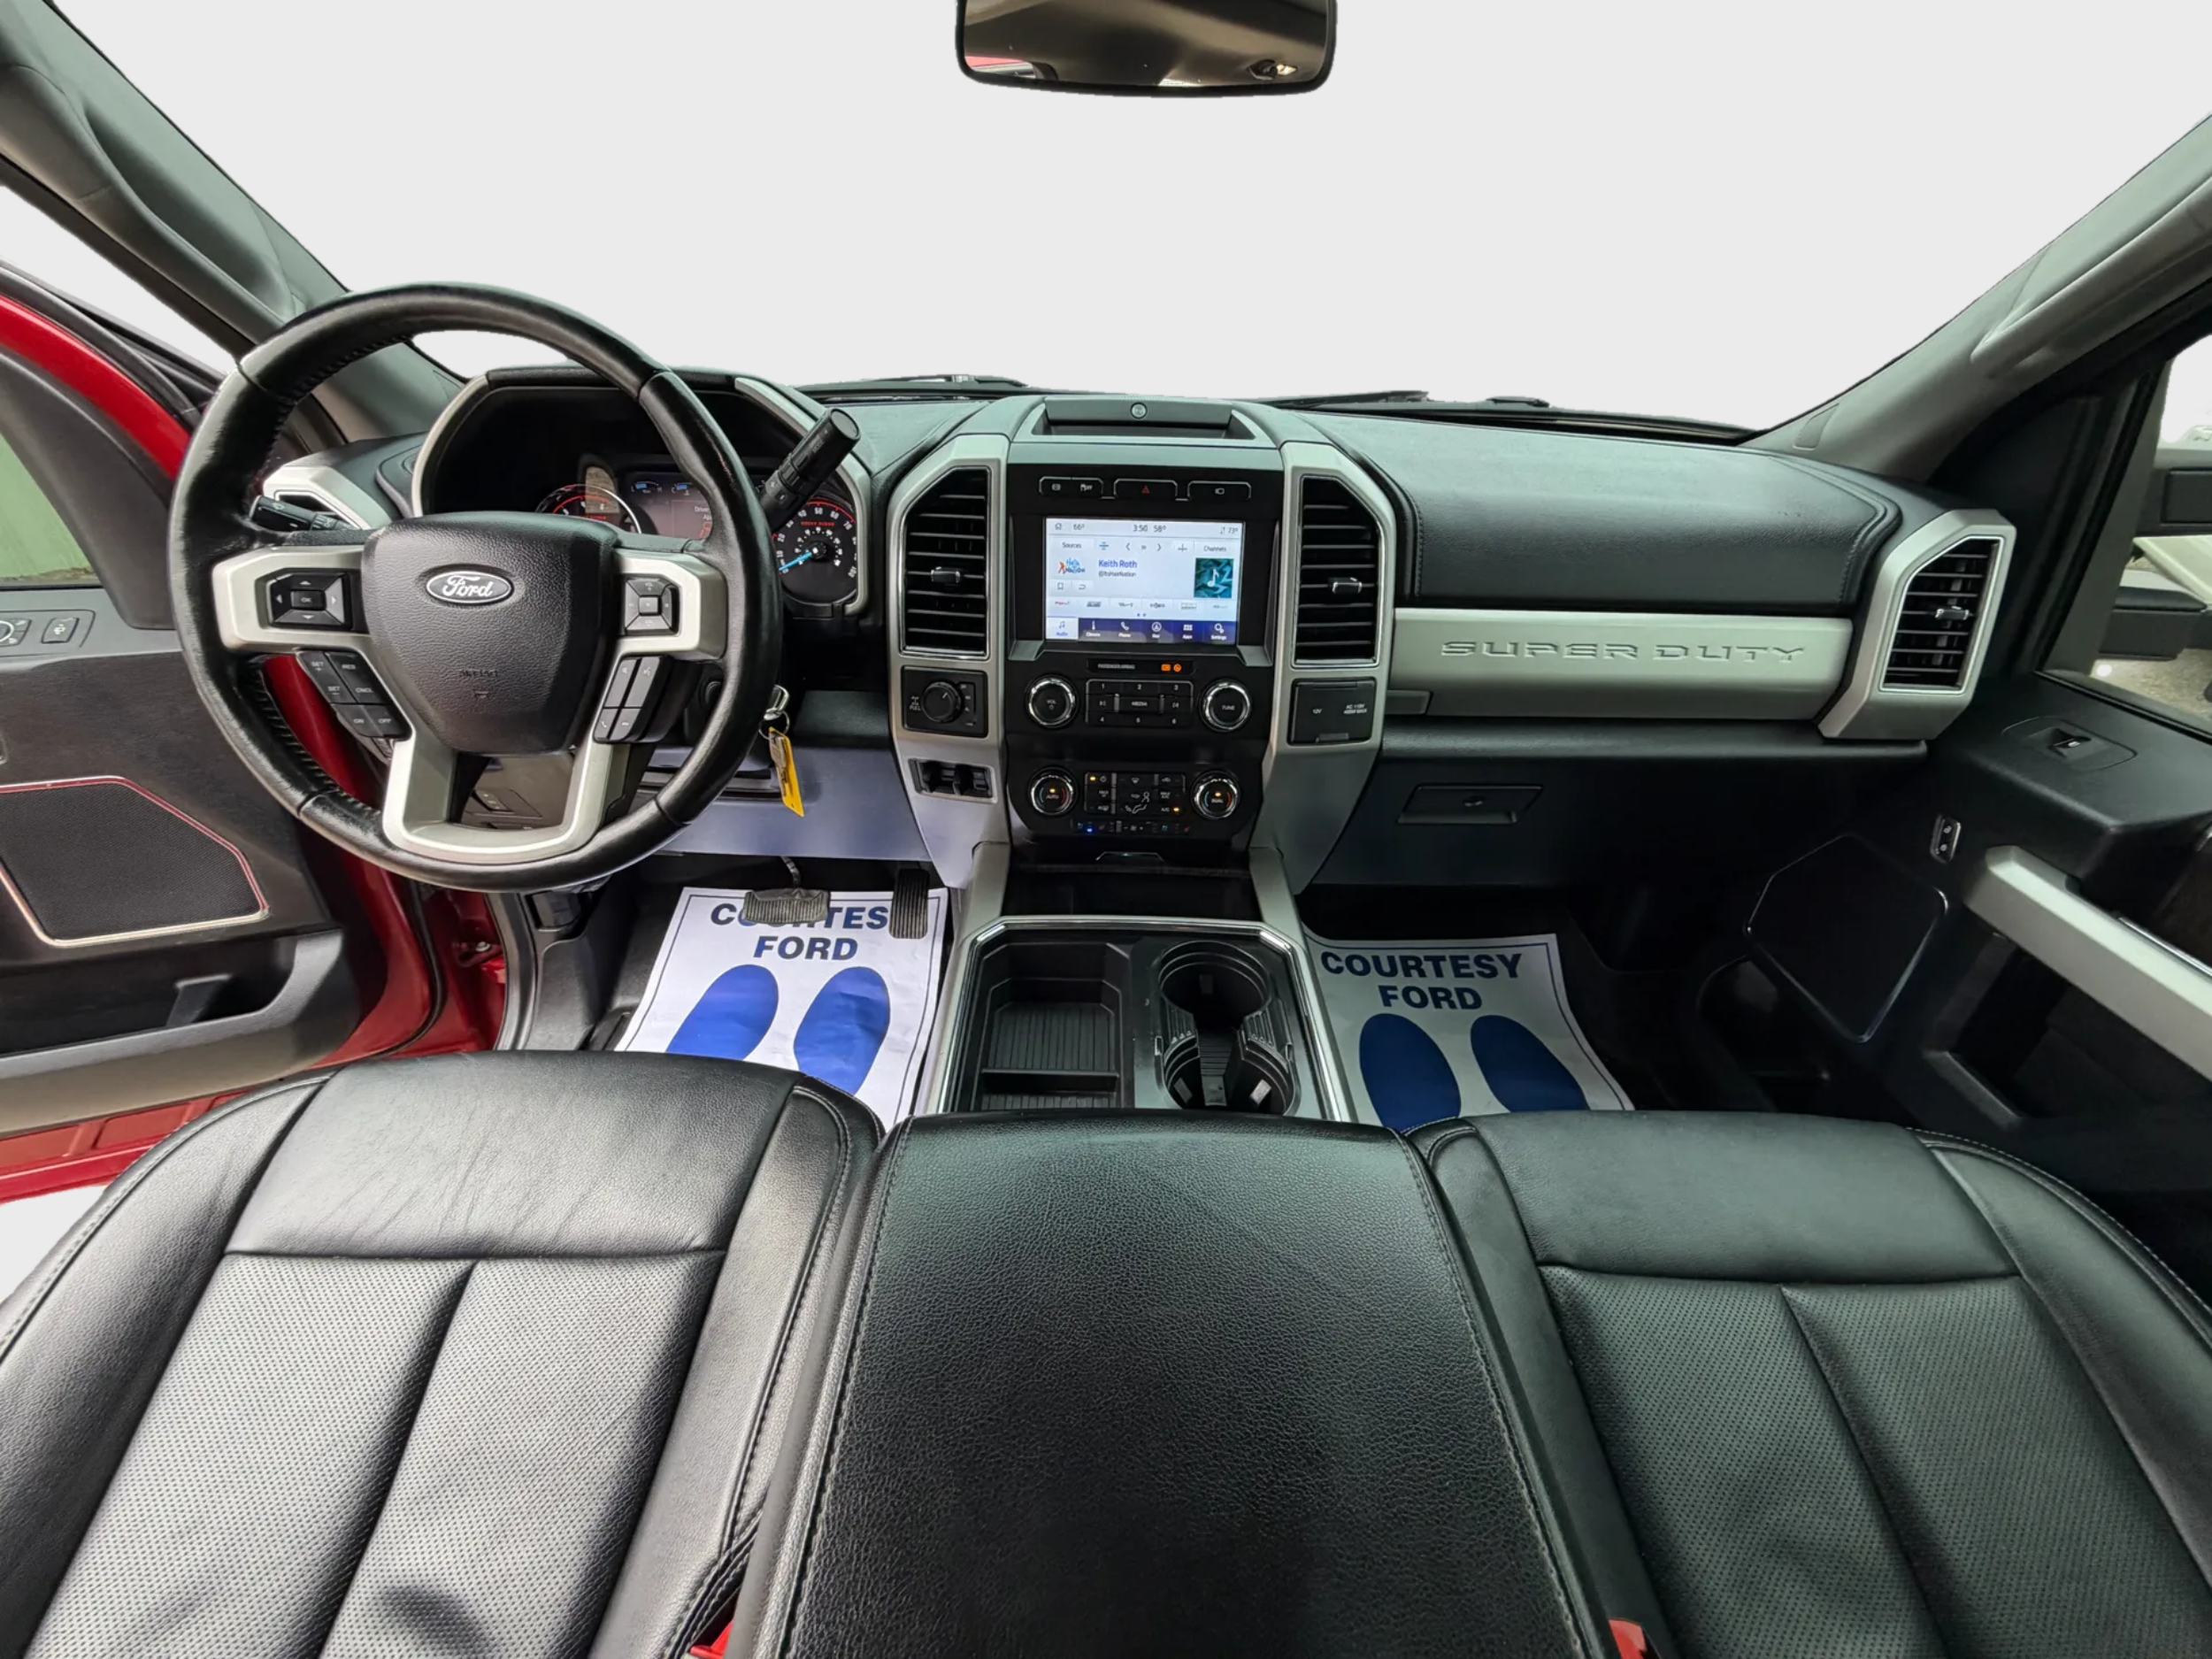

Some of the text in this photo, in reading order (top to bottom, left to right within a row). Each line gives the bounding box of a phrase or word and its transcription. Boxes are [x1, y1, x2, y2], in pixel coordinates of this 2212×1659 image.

[843, 520, 853, 530] 70
[1133, 524, 1148, 533] 3:50
[1098, 559, 1138, 569] Keith Roth
[442, 575, 494, 597] Ford
[1441, 641, 1805, 664] SUPER DUTY
[710, 902, 889, 930] CTES
[753, 935, 858, 960] FORD
[1320, 951, 1522, 979] COURTESY
[1378, 985, 1483, 1010] FORD
